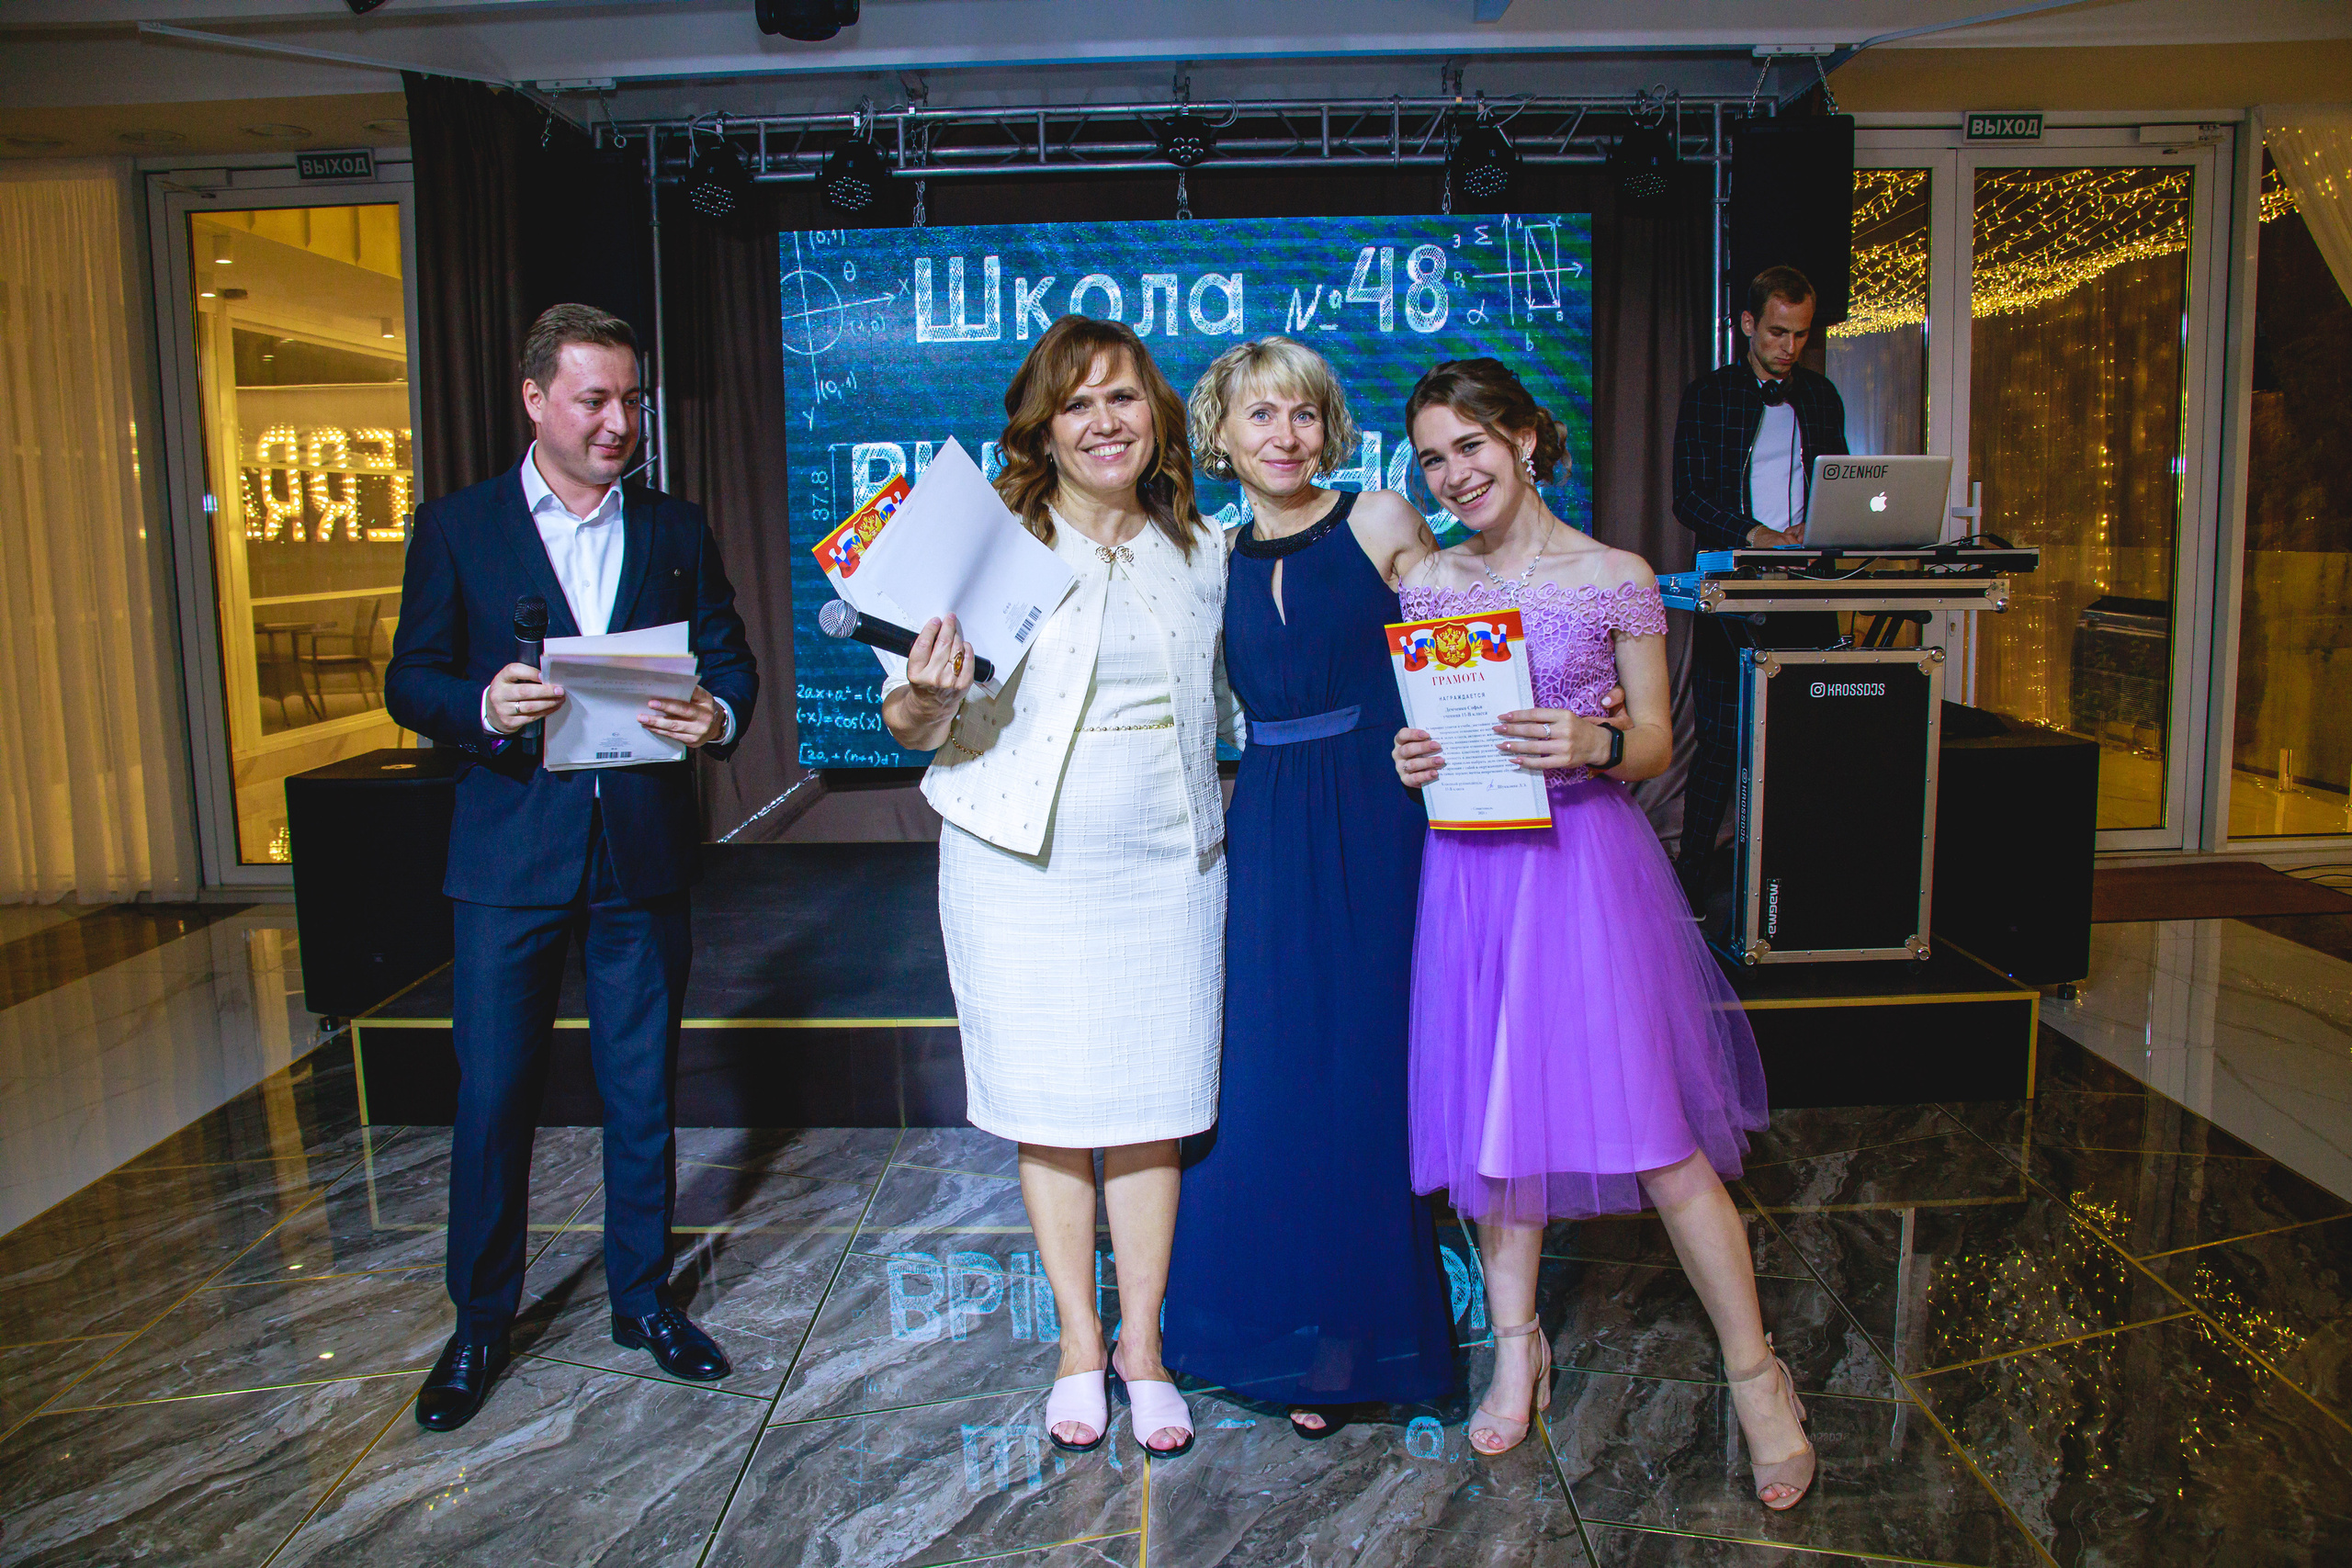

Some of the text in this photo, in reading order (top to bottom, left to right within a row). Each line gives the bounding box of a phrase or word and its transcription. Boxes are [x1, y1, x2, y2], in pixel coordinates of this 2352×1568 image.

[1972, 118, 2039, 136] ВЫХОД
[301, 157, 368, 175] ВЫХОД
[914, 256, 1243, 343] Школа
[1841, 465, 1889, 479] ZENKOF
[1431, 671, 1486, 686] ГРАМОТА
[1826, 682, 1886, 696] KROSSDJS
[1439, 692, 1486, 702] НАГРАЖДАЕТСЯ
